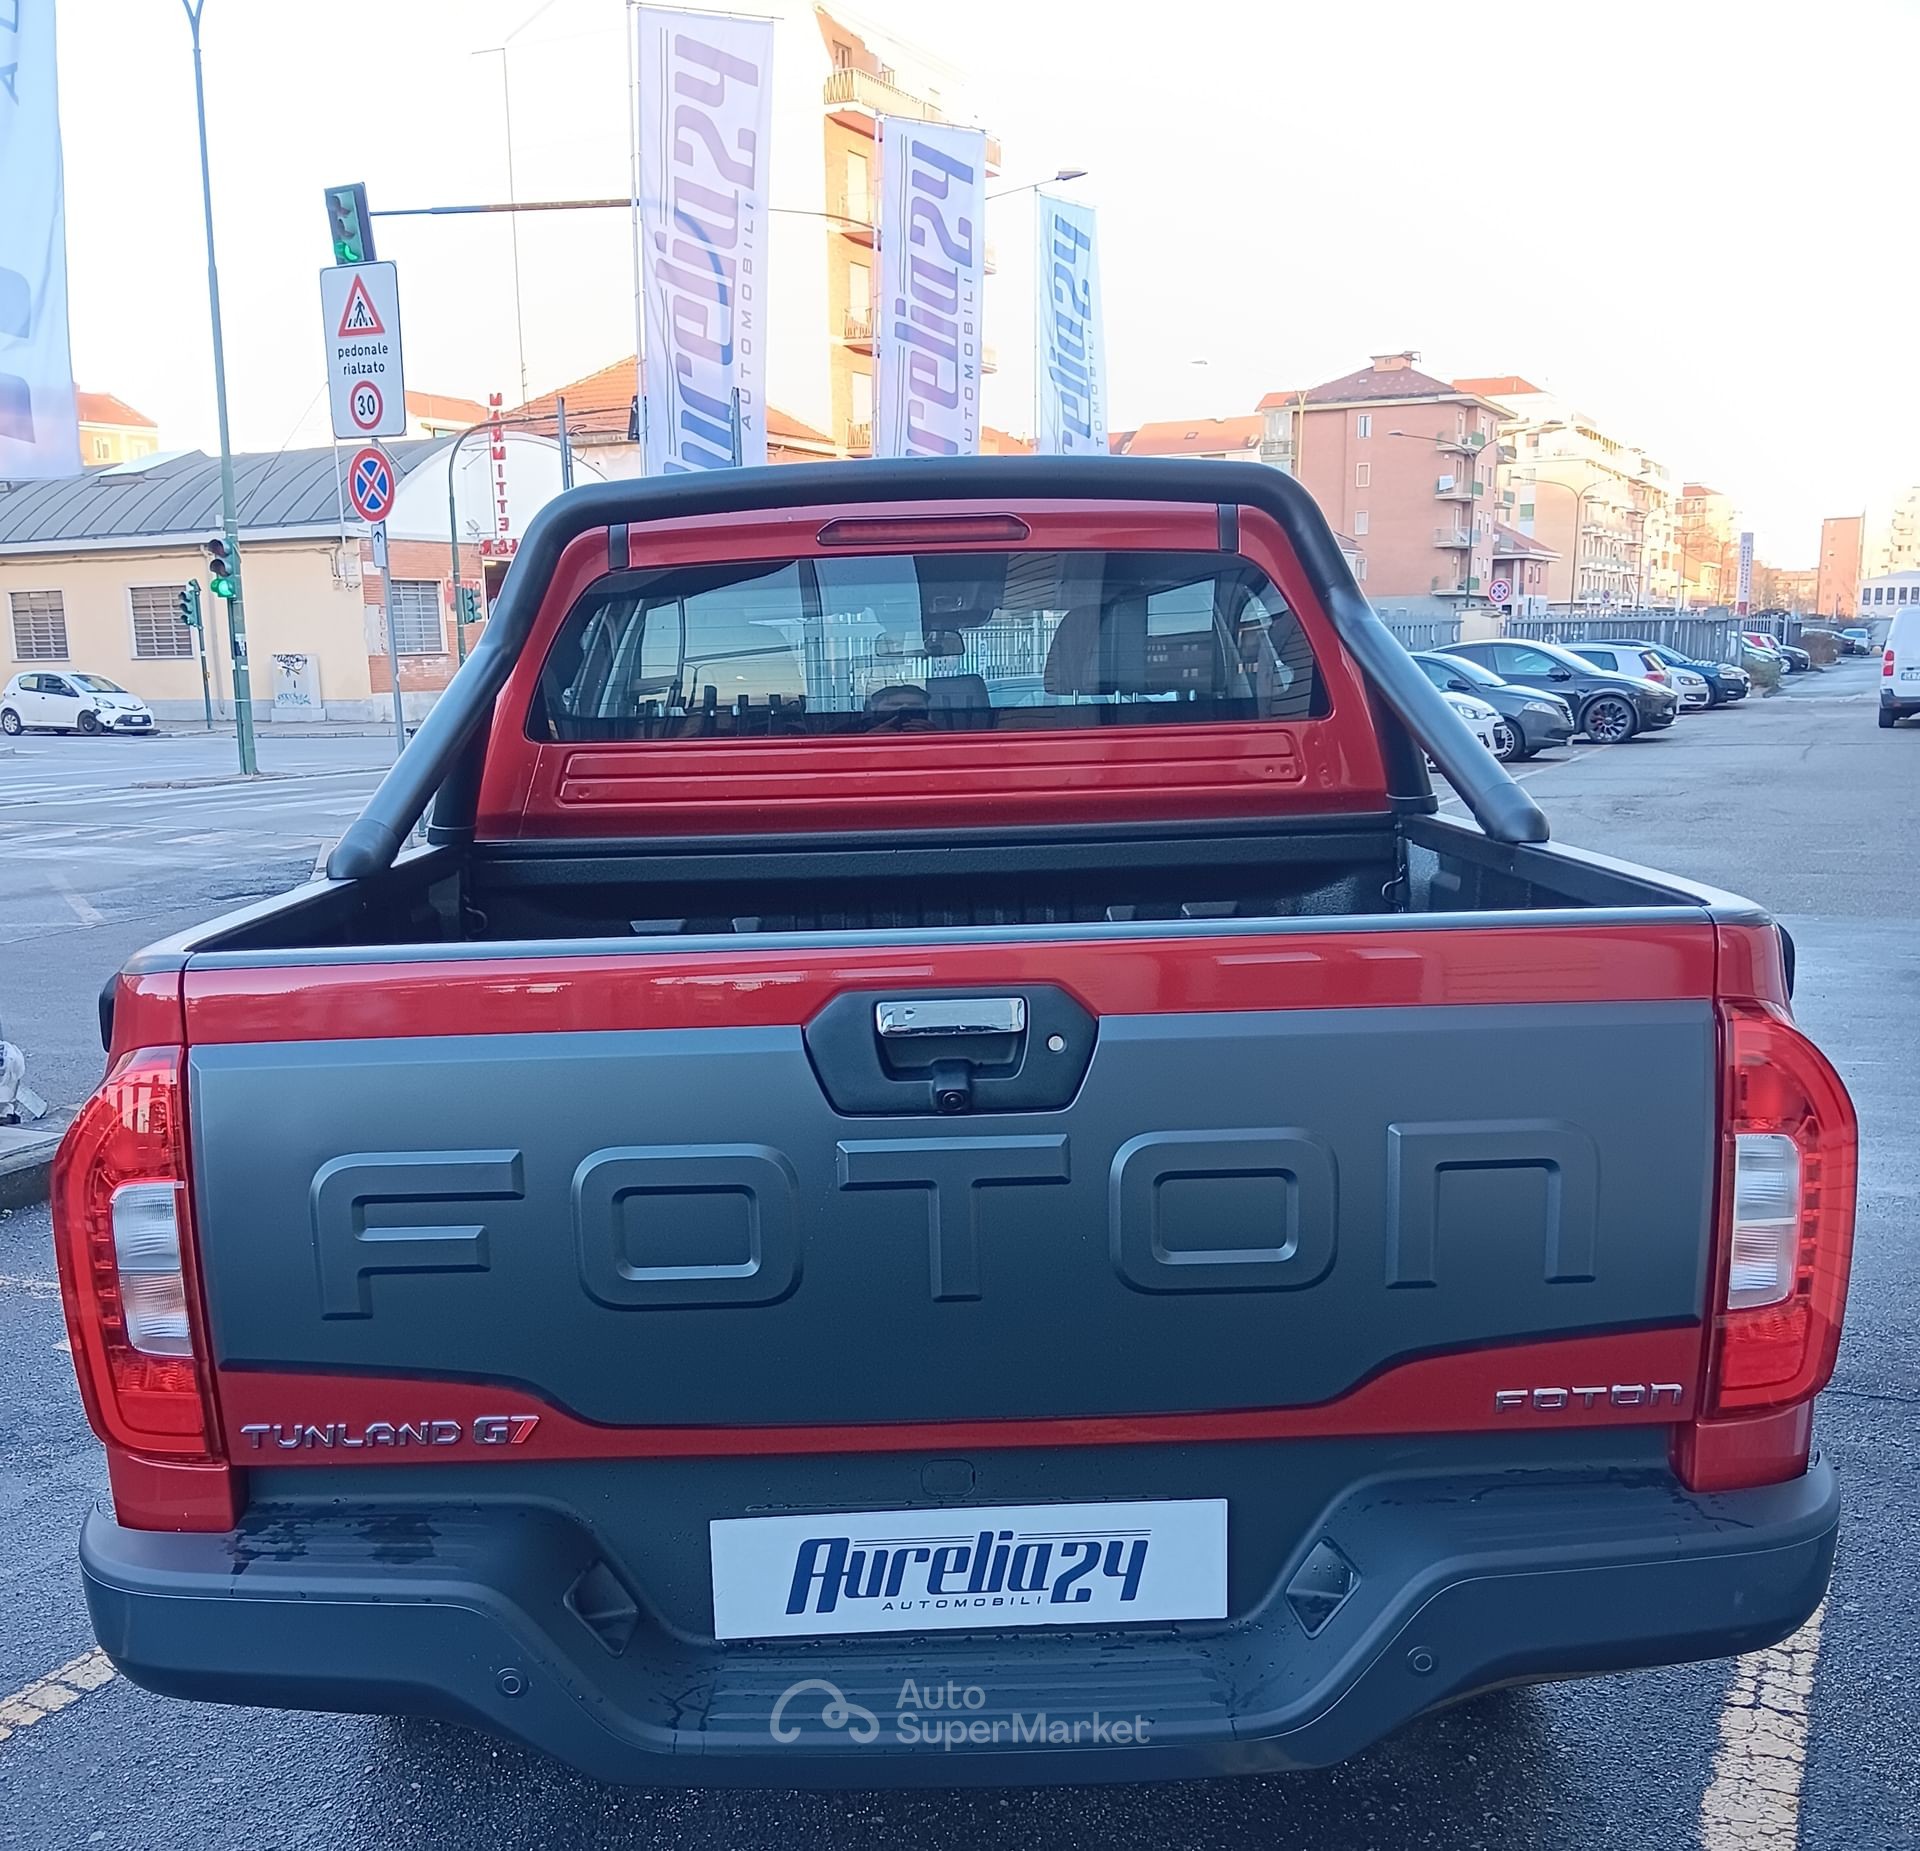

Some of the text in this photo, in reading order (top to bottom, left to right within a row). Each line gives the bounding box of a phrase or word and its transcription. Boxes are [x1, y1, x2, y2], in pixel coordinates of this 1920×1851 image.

[655, 34, 759, 474] urelia24
[737, 201, 754, 431] AUTOMOBILI
[895, 140, 973, 455] relia24
[338, 342, 389, 360] pedonale
[343, 361, 385, 375] rialzato
[964, 277, 973, 455] UTOMOBILI
[357, 394, 376, 416] 30
[241, 1414, 540, 1448] TUNLAND G7
[785, 1530, 1150, 1615] Aurelia24
[881, 1596, 1042, 1612] AUTOMOBILI
